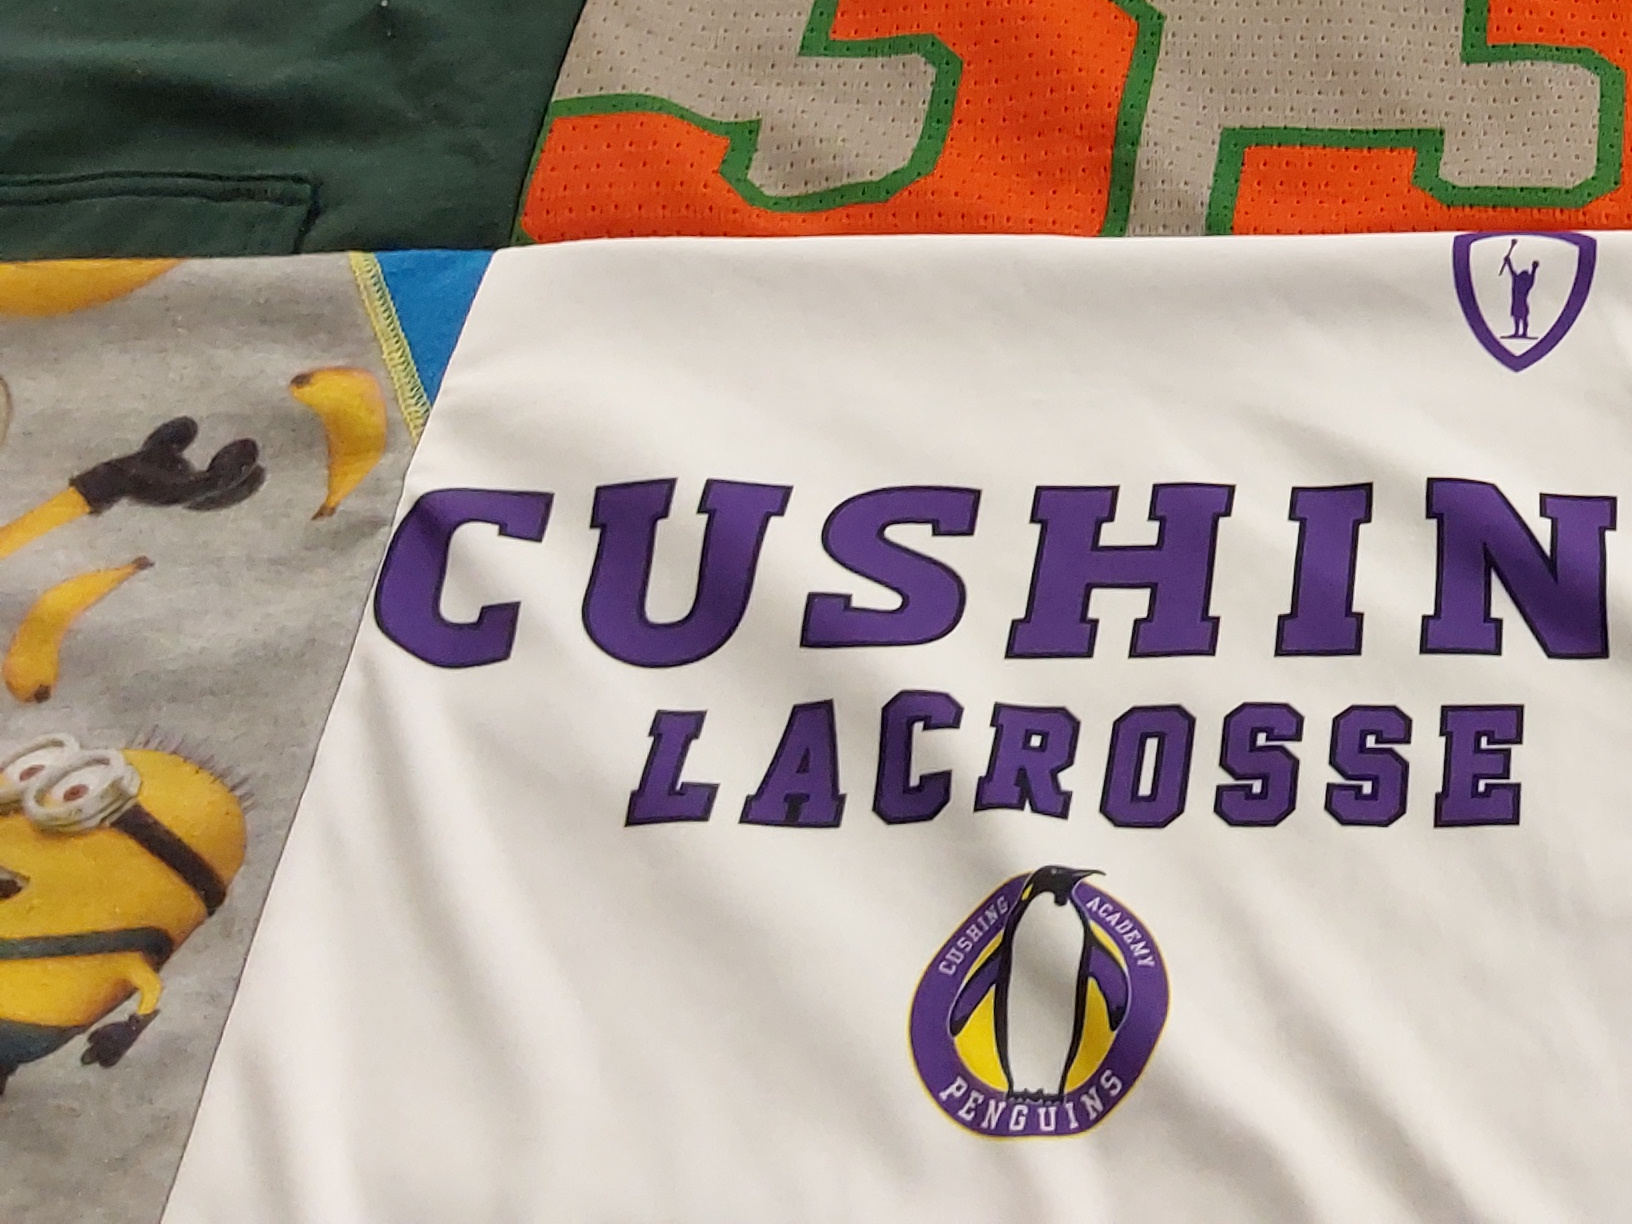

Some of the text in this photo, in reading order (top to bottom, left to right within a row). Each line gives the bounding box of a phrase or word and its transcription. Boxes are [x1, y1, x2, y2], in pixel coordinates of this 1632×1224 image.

[624, 688, 1525, 829] LACROSSE
[938, 895, 1156, 976] CUSHING ACADEMY
[938, 1069, 1124, 1132] PENGUINS
